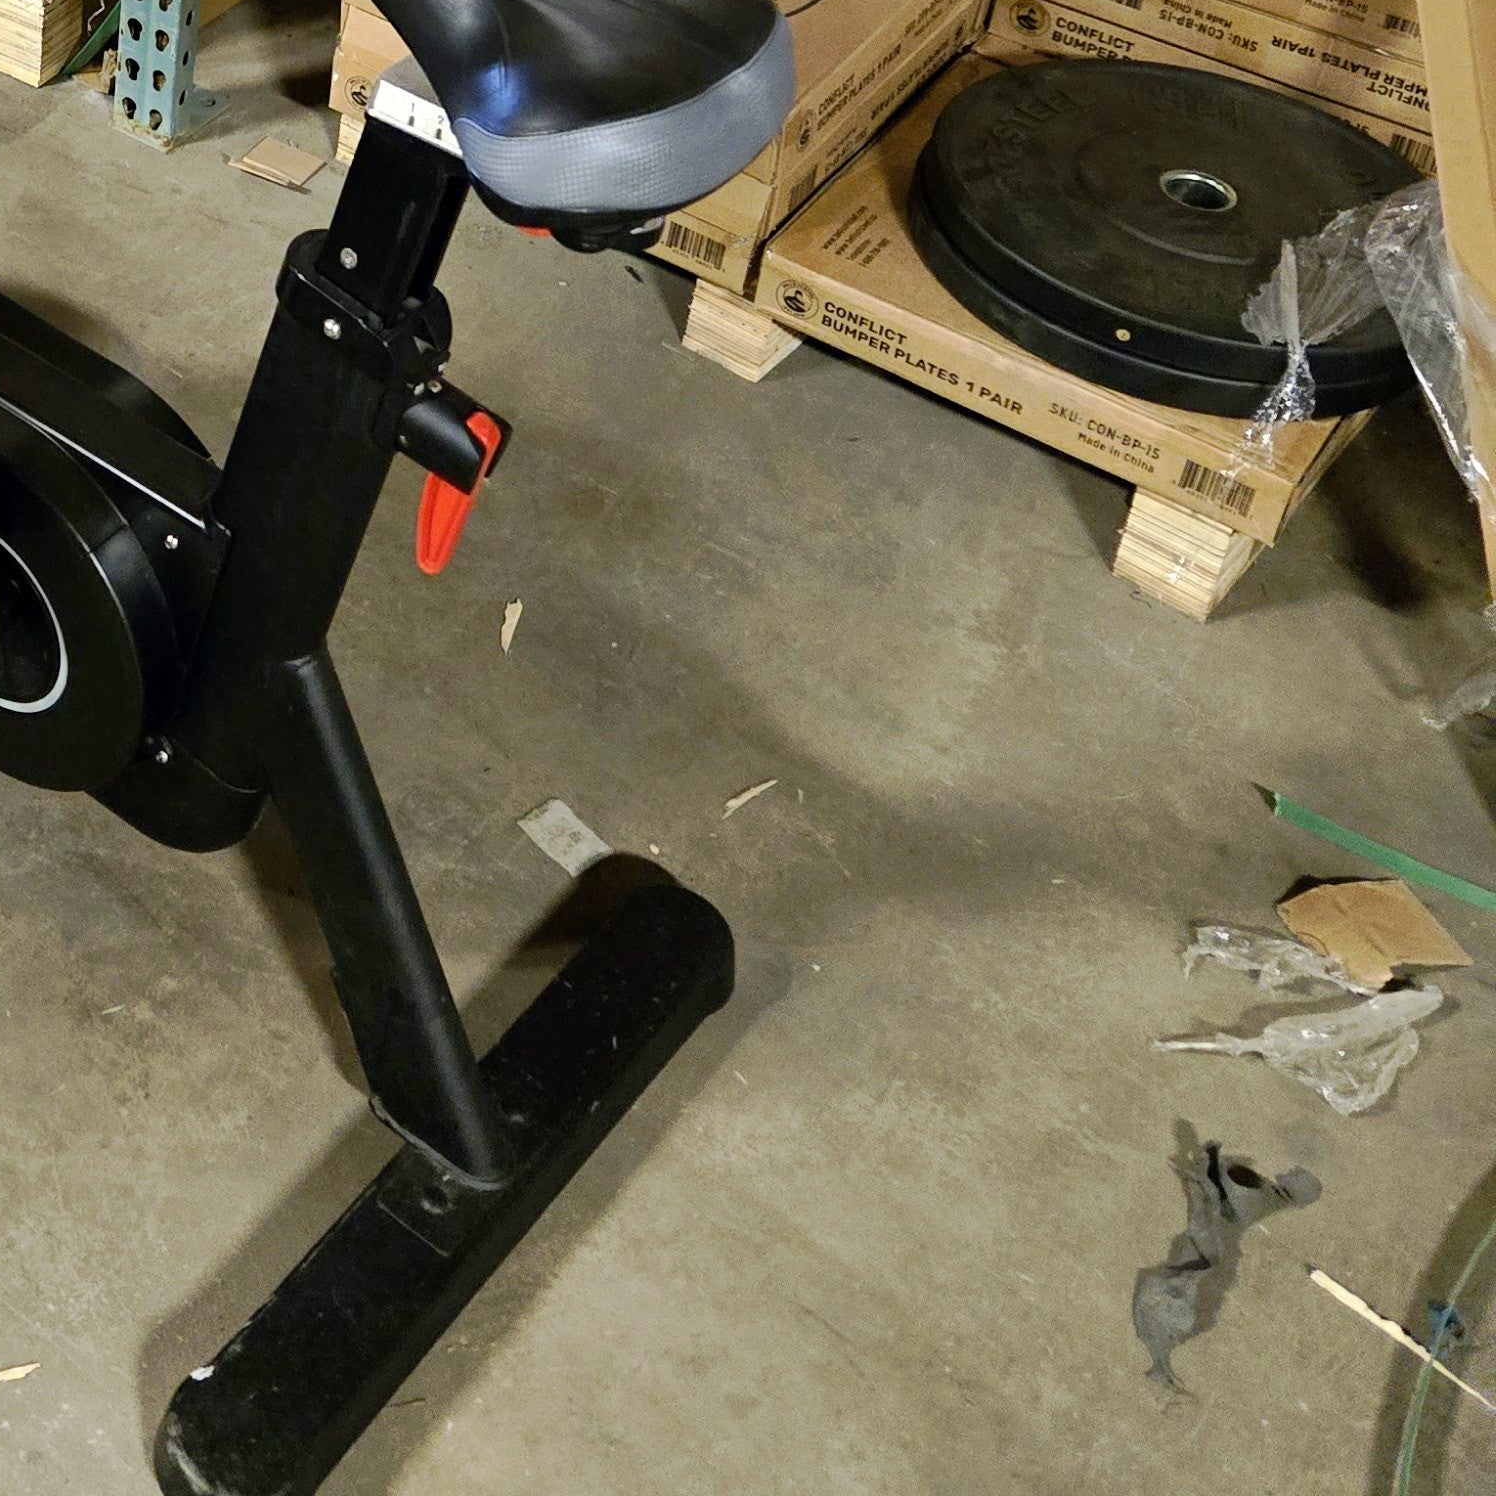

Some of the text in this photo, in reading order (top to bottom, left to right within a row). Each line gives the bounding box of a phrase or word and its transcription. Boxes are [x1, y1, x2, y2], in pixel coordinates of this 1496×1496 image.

[1056, 15, 1132, 54] CONFLICT
[1158, 7, 1224, 40] CON-BP-15
[1052, 30, 1124, 60] BUMPER
[1321, 50, 1380, 81] PLATES
[824, 299, 905, 347] CONFLICT
[821, 313, 890, 356] BUMPER
[894, 346, 959, 387] PLATES
[1050, 400, 1159, 461] SKU: CON-BP-15
[1077, 431, 1154, 474] Made in China
